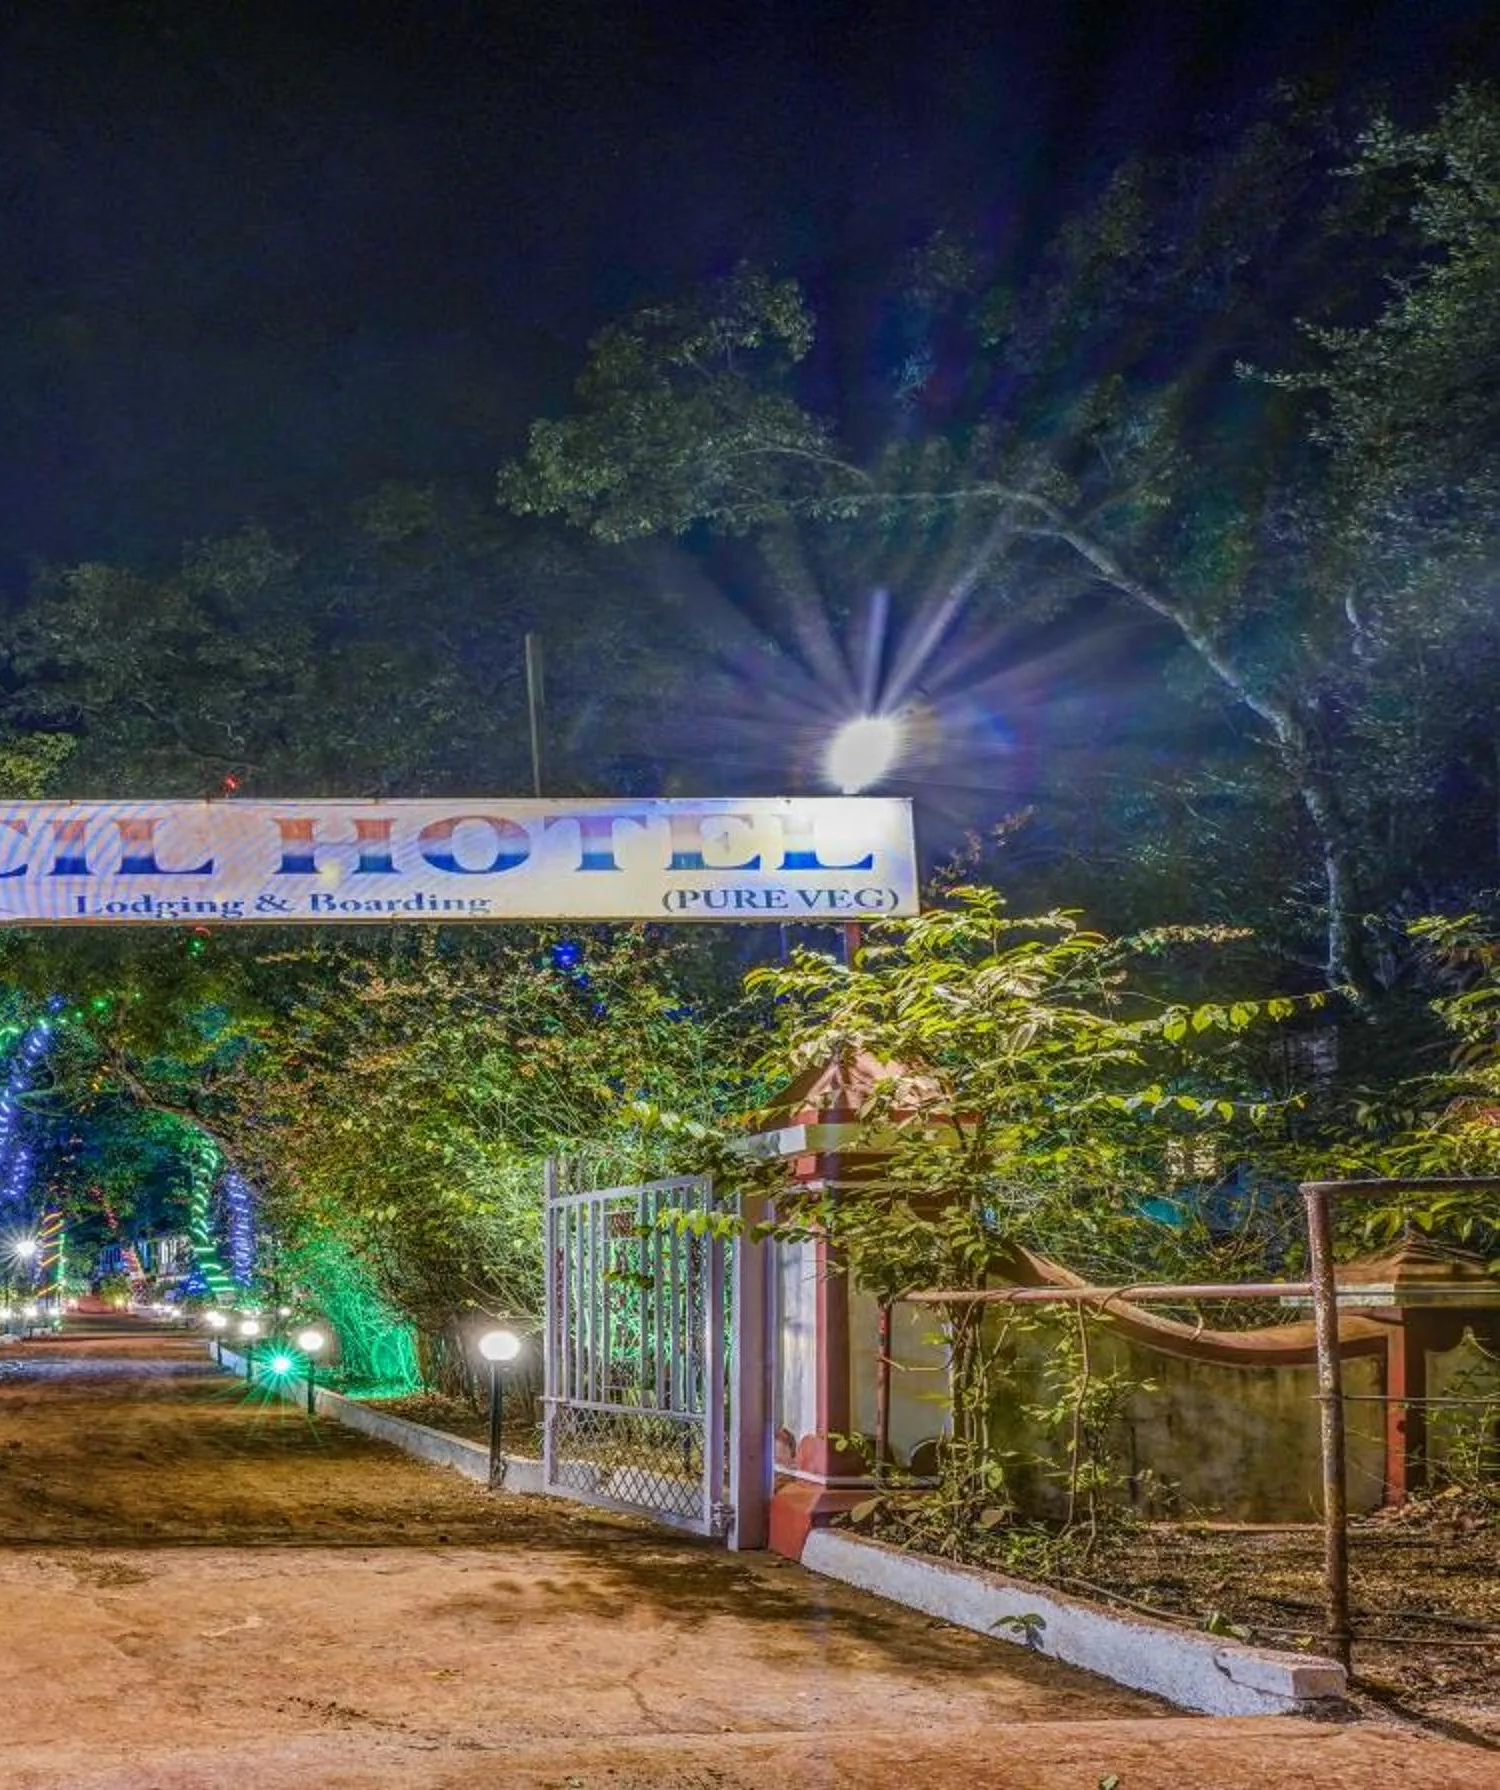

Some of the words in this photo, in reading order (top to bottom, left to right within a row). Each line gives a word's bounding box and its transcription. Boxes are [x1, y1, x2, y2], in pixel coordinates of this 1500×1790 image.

[272, 813, 874, 875] HOTEL
[74, 893, 245, 919] Lodging
[255, 893, 294, 913] &
[309, 891, 493, 915] Boarding
[661, 887, 789, 913] (PURE
[793, 887, 899, 912] VEG)
